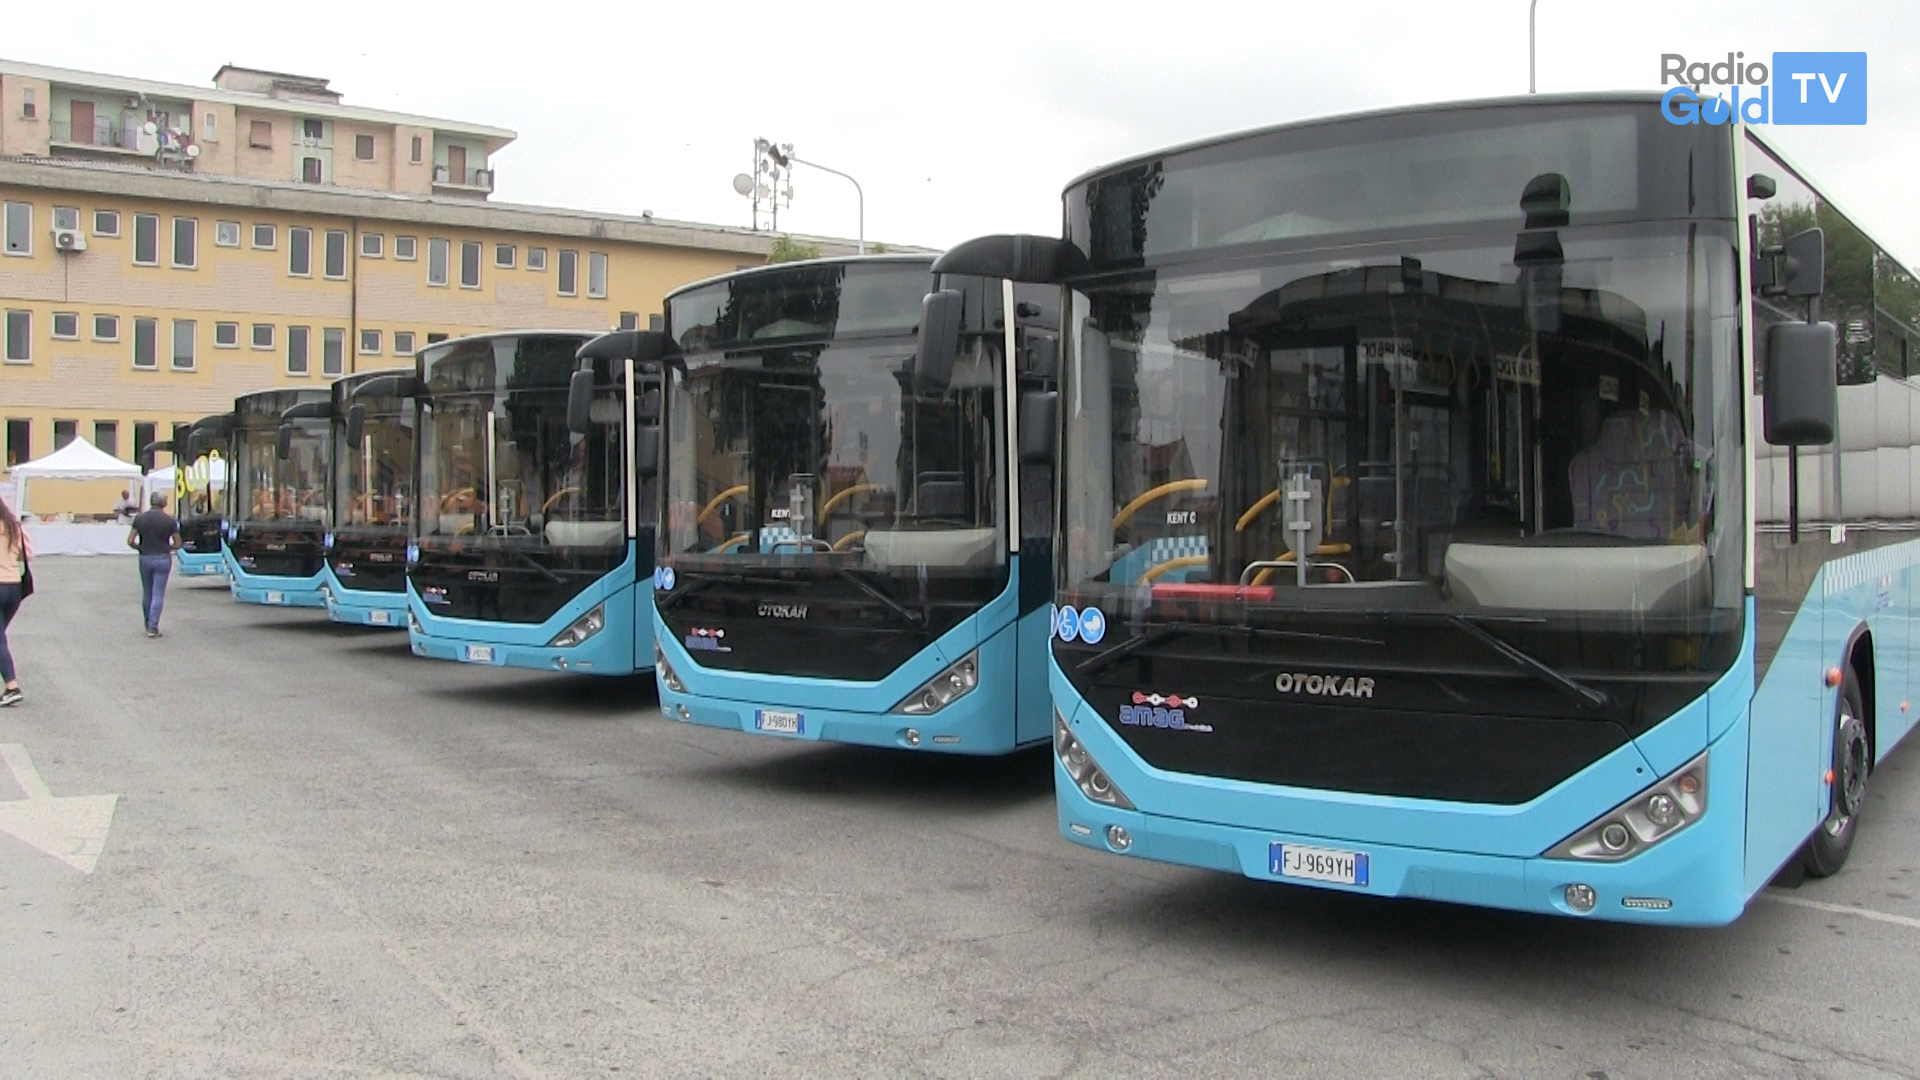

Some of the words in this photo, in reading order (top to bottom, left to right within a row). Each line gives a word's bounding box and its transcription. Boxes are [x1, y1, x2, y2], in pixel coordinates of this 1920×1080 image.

[1167, 511, 1189, 524] KENT
[757, 603, 808, 619] OTOKAR
[1275, 673, 1376, 698] OTOKAR
